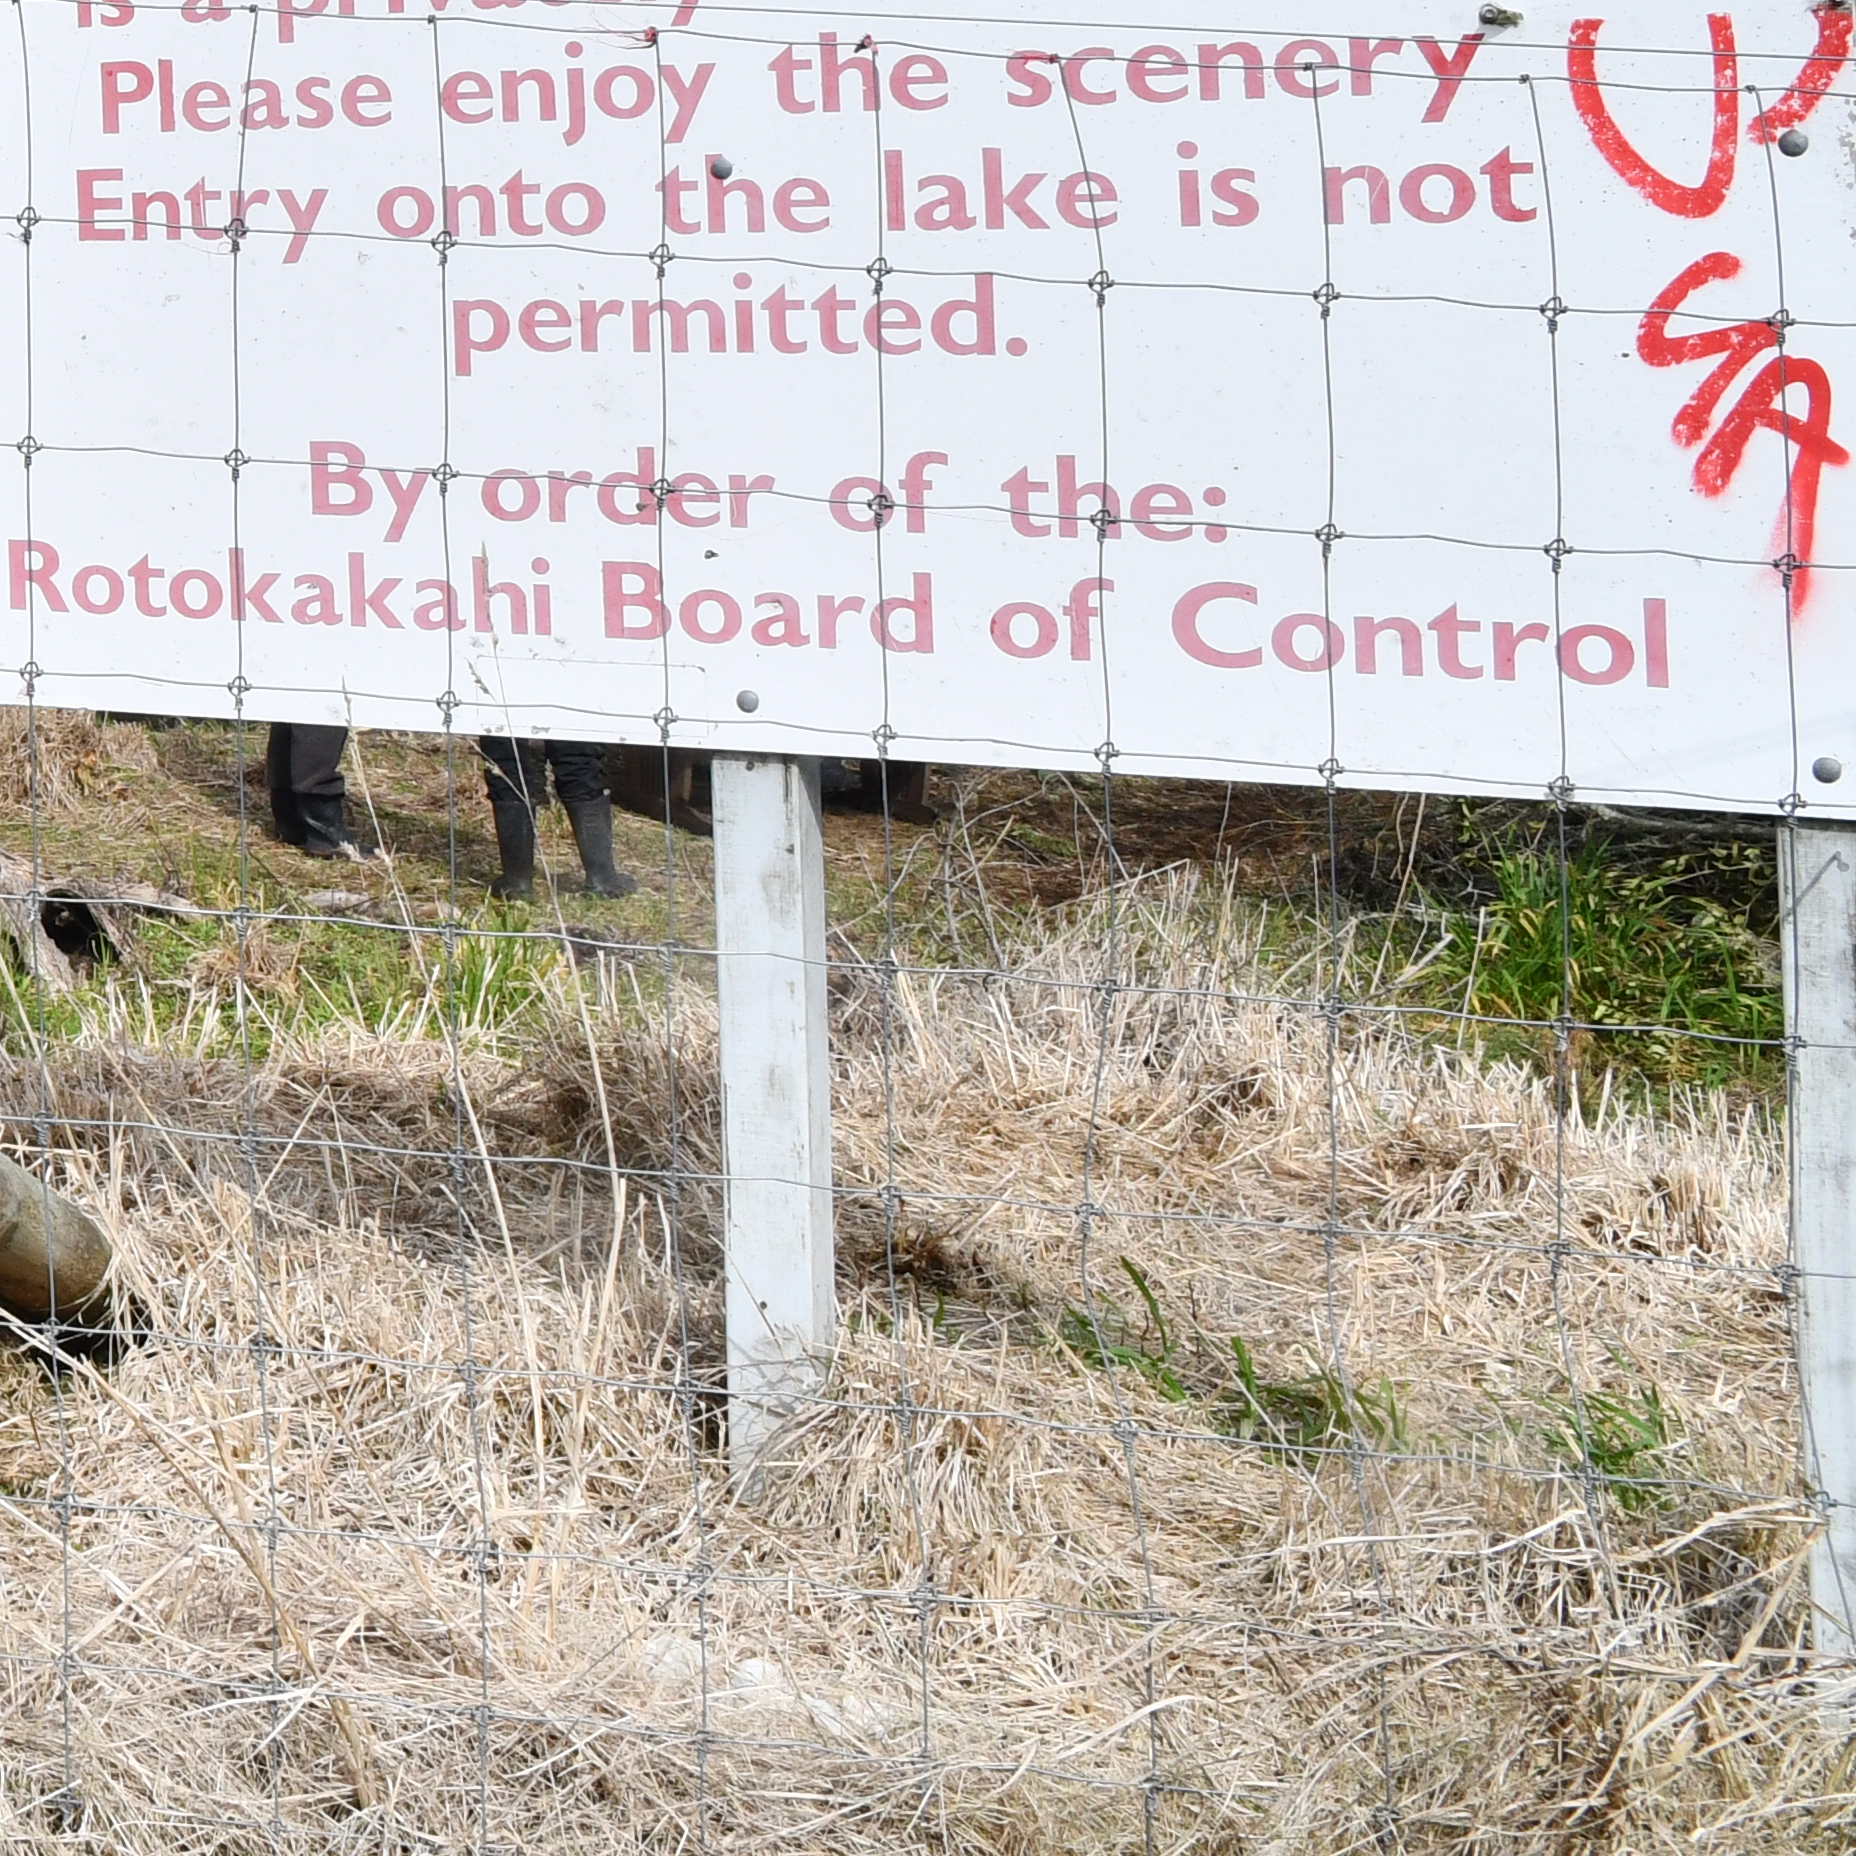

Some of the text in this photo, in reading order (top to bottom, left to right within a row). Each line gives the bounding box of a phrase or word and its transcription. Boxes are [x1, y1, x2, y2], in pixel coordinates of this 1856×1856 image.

[100, 31, 1487, 145] Please enjoy the scenery
[76, 141, 1538, 264] Entry onto the lake is not
[453, 272, 1028, 377] permitted.
[310, 441, 1229, 543] By order of the:
[8, 539, 1669, 689] Rotokakahi Board of Control
